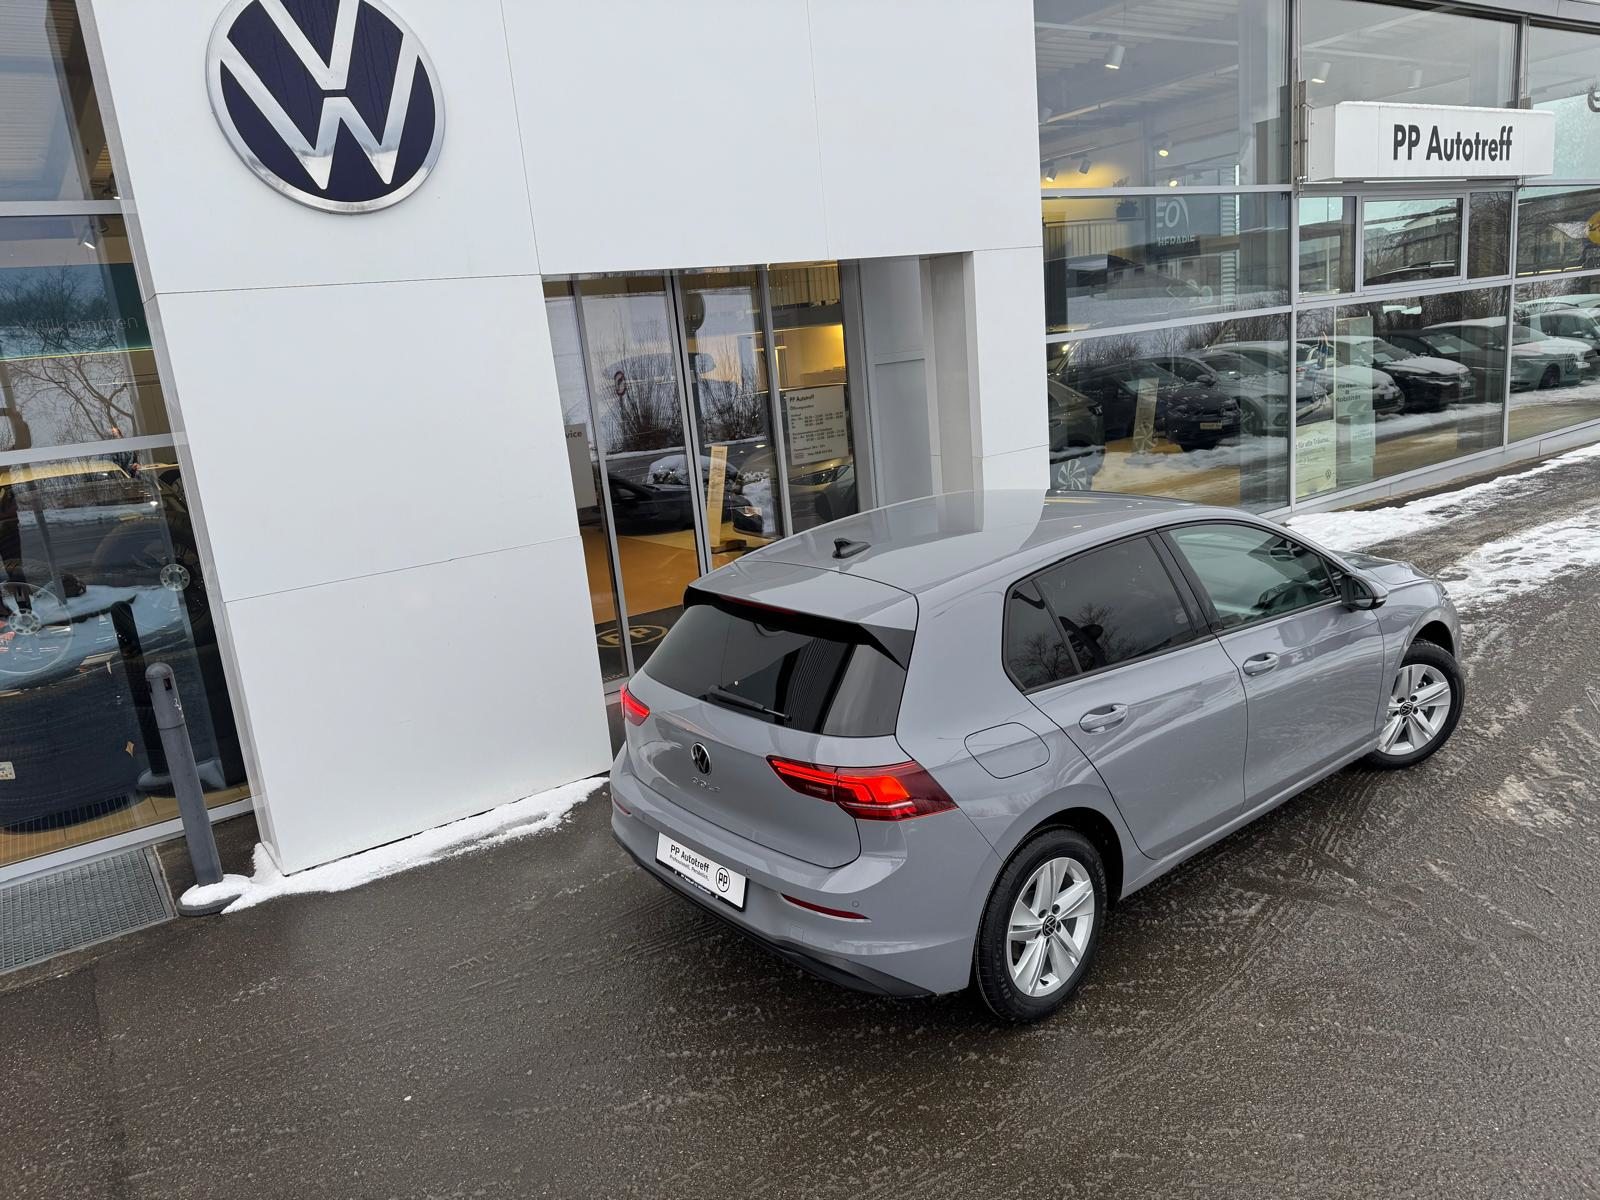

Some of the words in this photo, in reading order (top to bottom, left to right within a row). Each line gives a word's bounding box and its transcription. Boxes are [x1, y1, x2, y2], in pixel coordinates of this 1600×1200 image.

[1393, 123, 1421, 161] PP
[1425, 125, 1513, 162] Autotreff
[670, 844, 681, 856] PP
[680, 850, 710, 873] Autotreff
